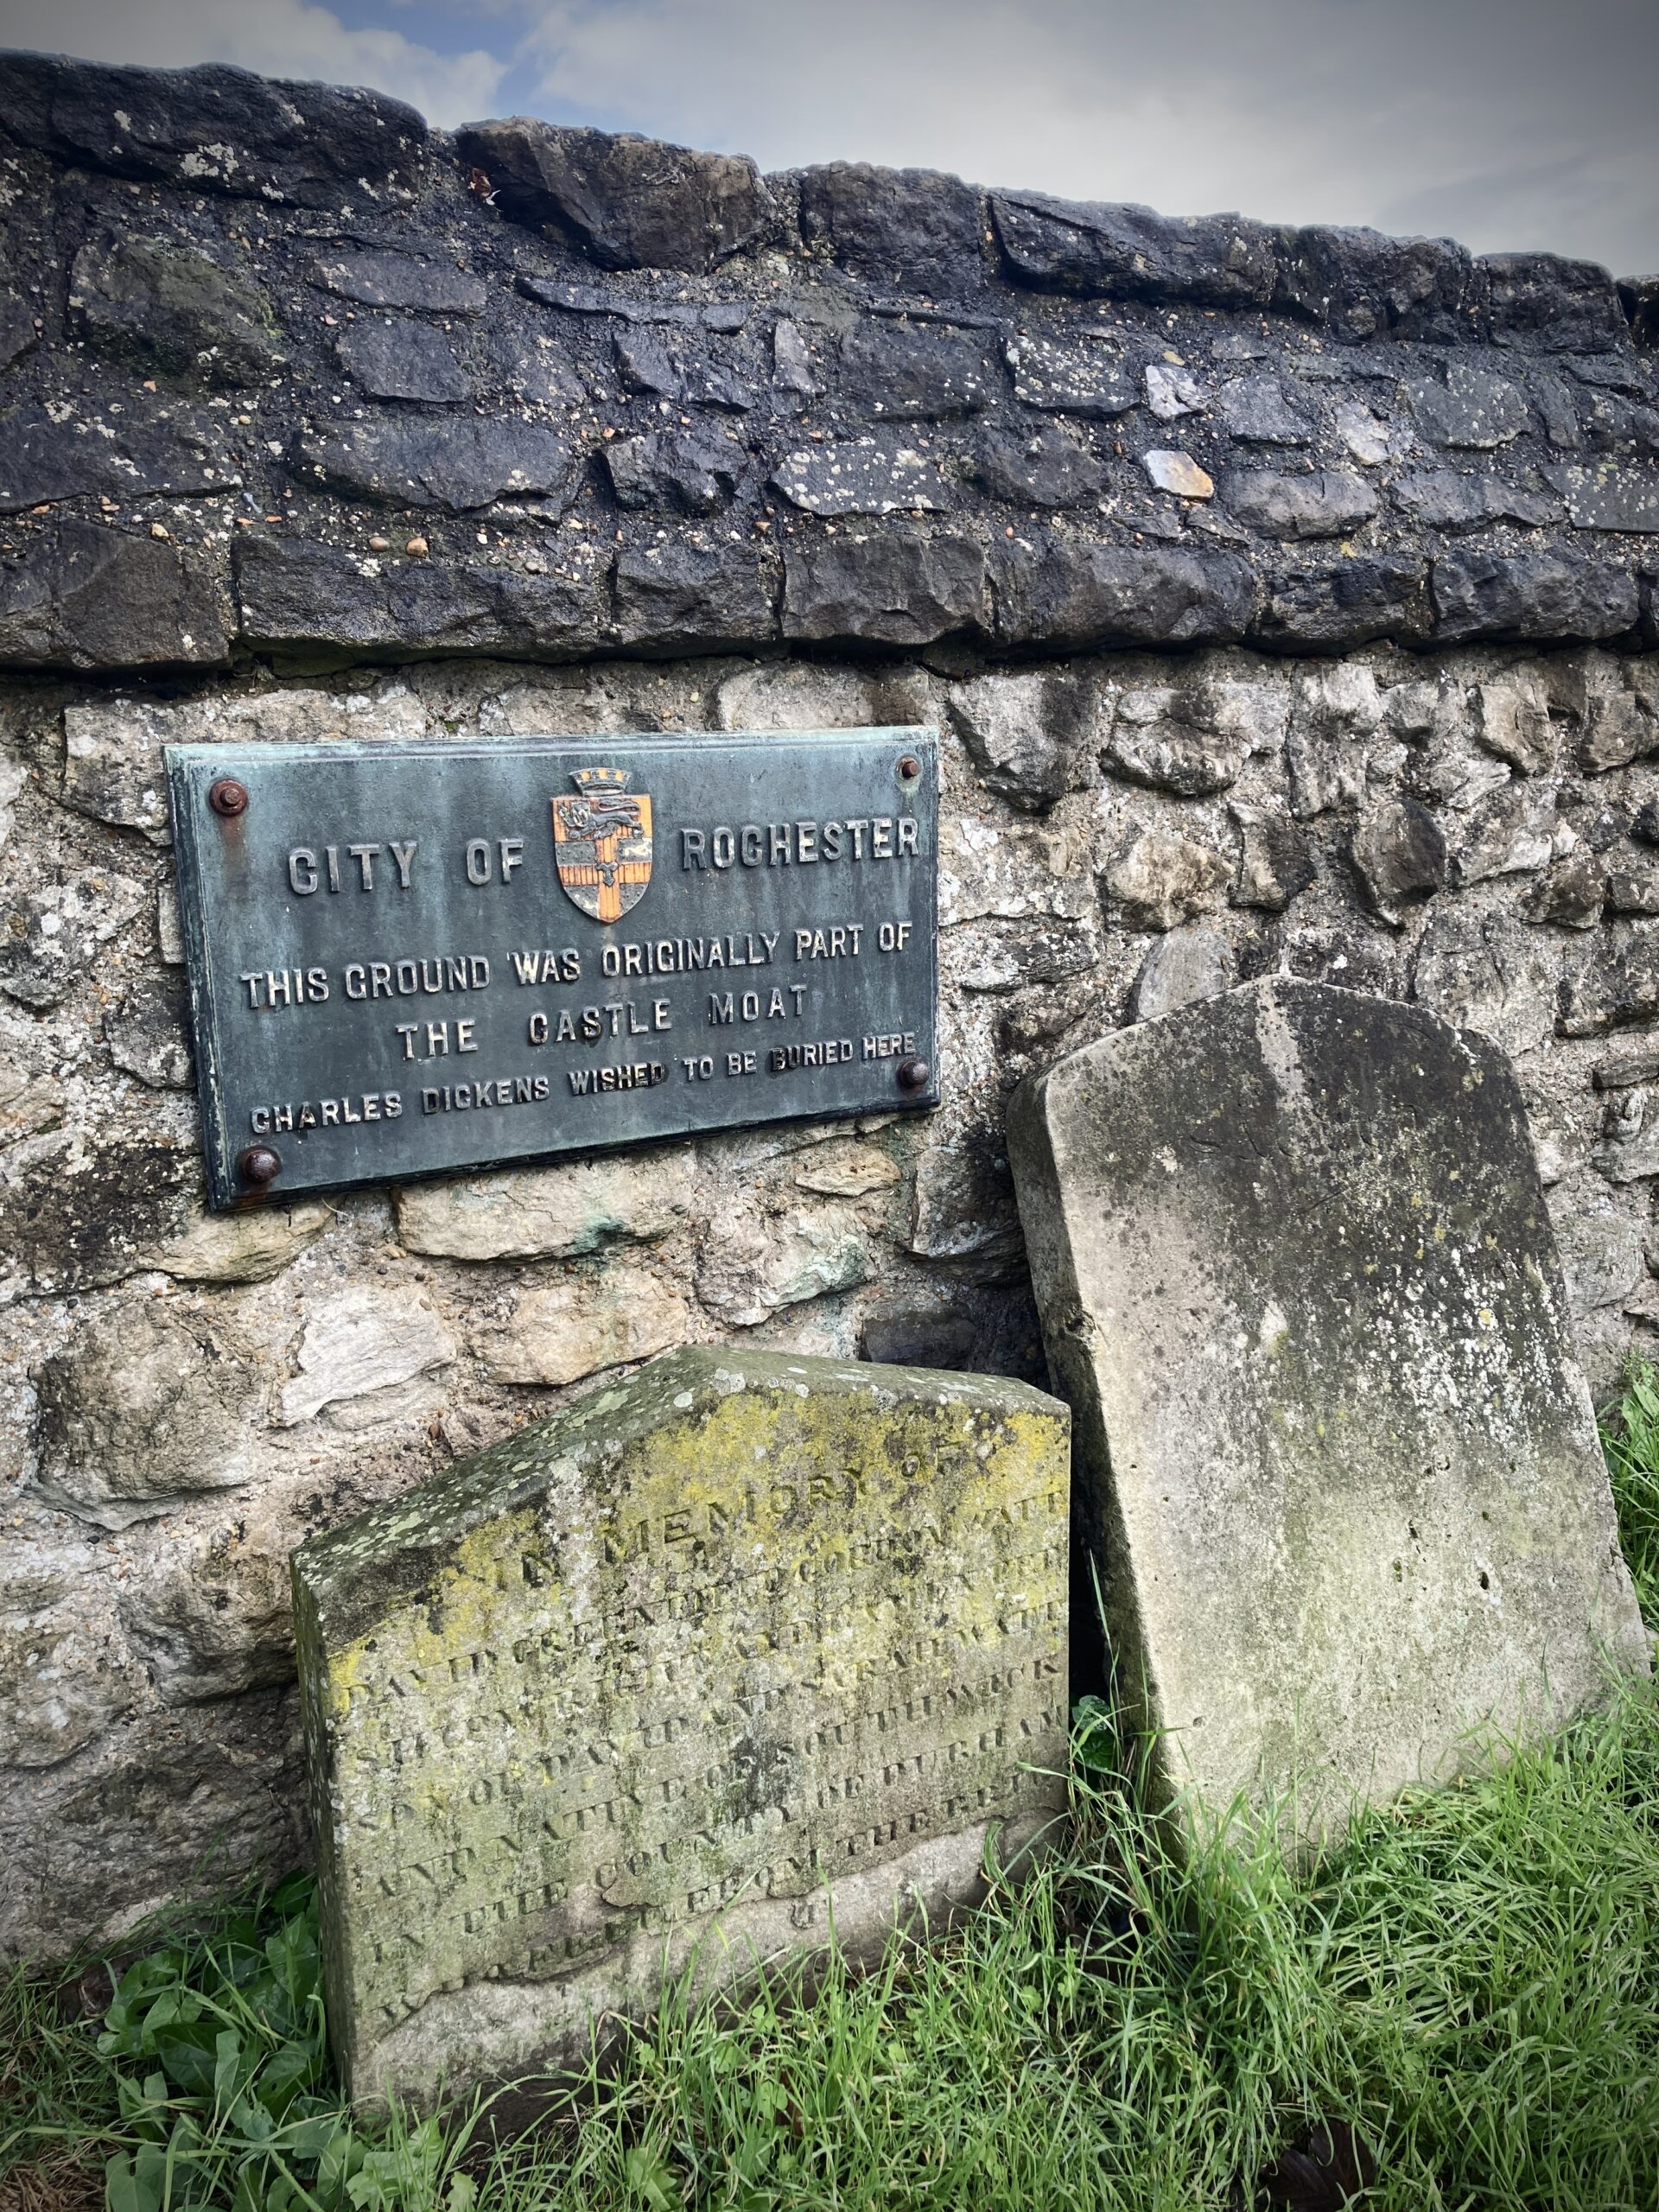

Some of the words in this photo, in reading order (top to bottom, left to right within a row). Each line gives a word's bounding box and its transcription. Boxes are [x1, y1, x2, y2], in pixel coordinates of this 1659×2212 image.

[289, 840, 417, 896] CITY
[467, 838, 524, 886] OF
[681, 817, 918, 870] ROCHESTER
[240, 968, 329, 1009] THIS
[346, 956, 491, 1000] GROUND
[508, 948, 580, 986] WAS
[601, 933, 779, 978] ORIGINALLY
[796, 925, 863, 961] PART
[879, 922, 912, 951] OF
[396, 1020, 479, 1060] THE
[531, 999, 671, 1046] CASTLE
[709, 985, 807, 1026] MOAT
[251, 1090, 402, 1134] CHARLES
[422, 1076, 550, 1115] DICKENS
[568, 1058, 665, 1095] WISHED
[683, 1056, 714, 1081] TO
[727, 1051, 756, 1077] BE
[770, 1039, 853, 1071] BURIED
[861, 1033, 915, 1059] HERE
[605, 1465, 868, 1565] MEMORY
[901, 1438, 963, 1484] OF
[372, 1845, 475, 1903] AND
[487, 1777, 684, 1862] NATIVE
[777, 1654, 1060, 1766] SOUTHWICK
[537, 1713, 691, 1786] DAVID
[371, 1928, 425, 1967] IN
[449, 1878, 569, 1940] THE
[594, 1798, 798, 1891] COUNTY
[816, 1771, 866, 1811] OF
[881, 1703, 1067, 1788] DURHAM
[835, 1808, 929, 1861] THE
